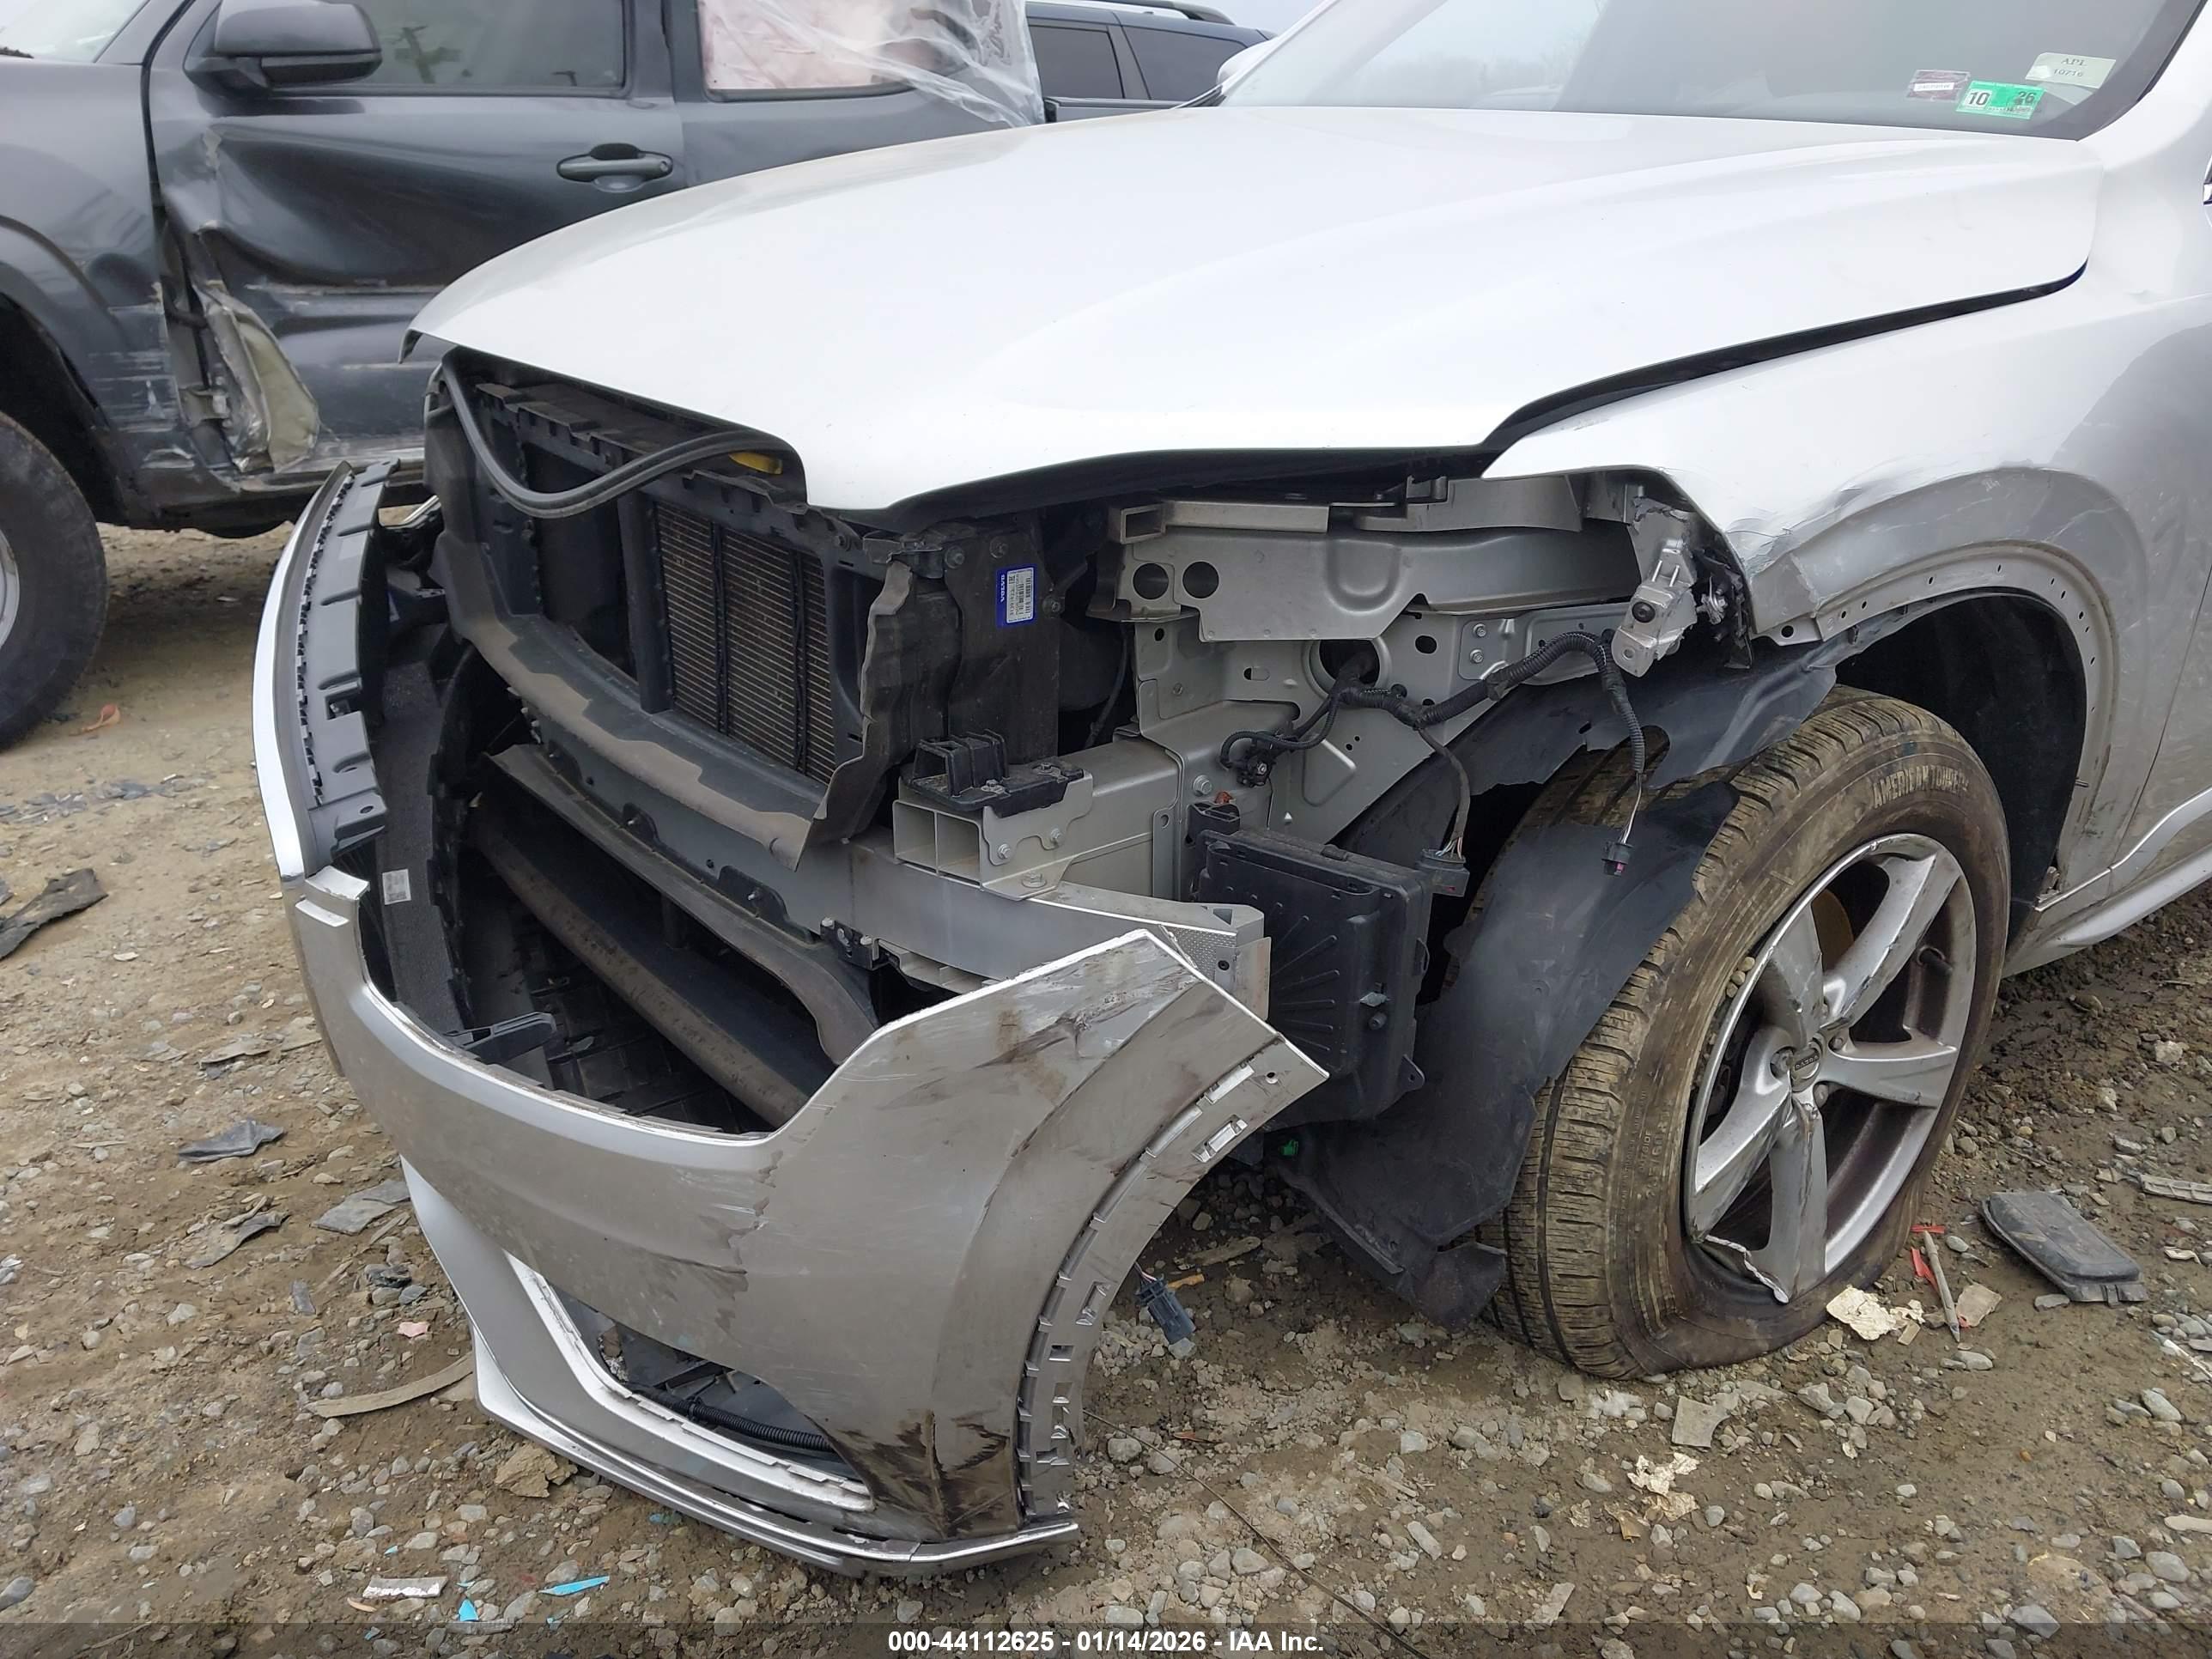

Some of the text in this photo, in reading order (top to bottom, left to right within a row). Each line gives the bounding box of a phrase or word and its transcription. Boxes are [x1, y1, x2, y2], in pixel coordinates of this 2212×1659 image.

[2061, 57, 2087, 67] APL
[1968, 91, 1990, 106] 10
[2018, 90, 2037, 104] 26
